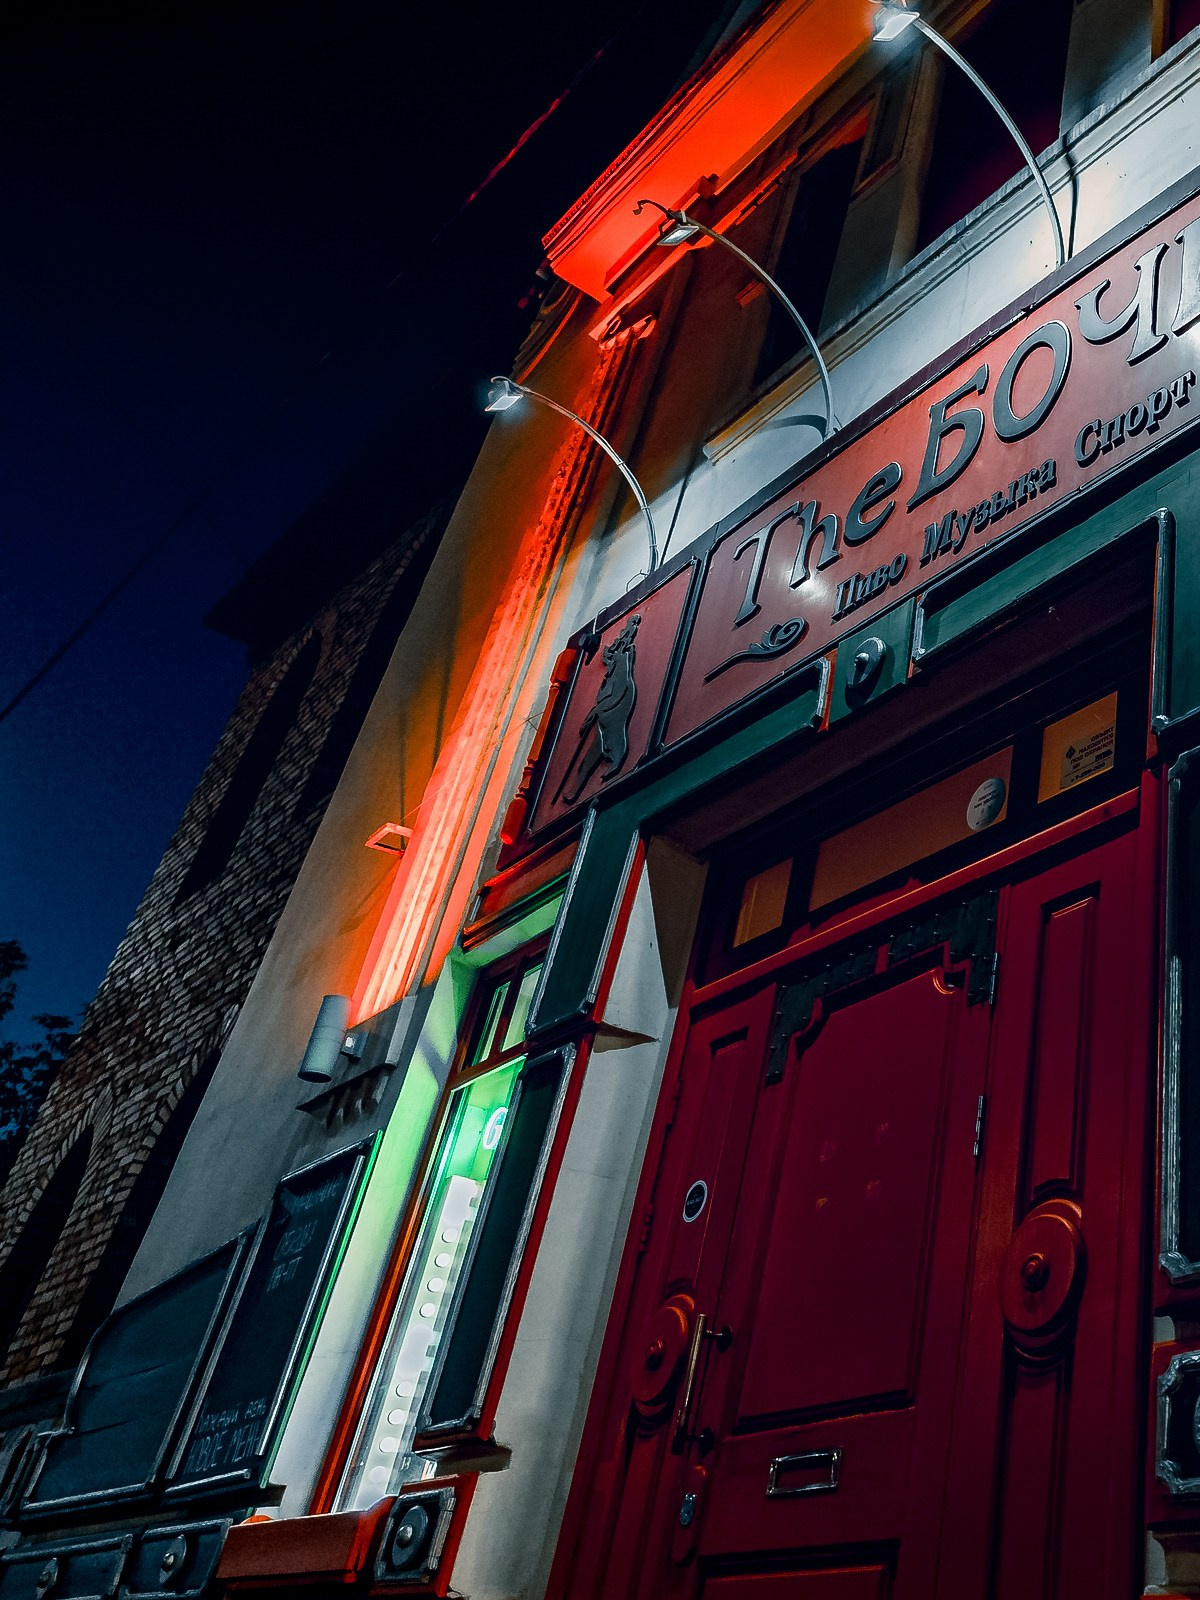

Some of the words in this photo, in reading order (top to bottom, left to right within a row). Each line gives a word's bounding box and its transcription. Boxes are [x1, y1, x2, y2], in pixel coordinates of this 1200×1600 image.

[733, 461, 903, 626] The
[831, 552, 908, 623] Пиво
[919, 458, 1058, 569] Музыка
[1073, 370, 1197, 468] Спорт
